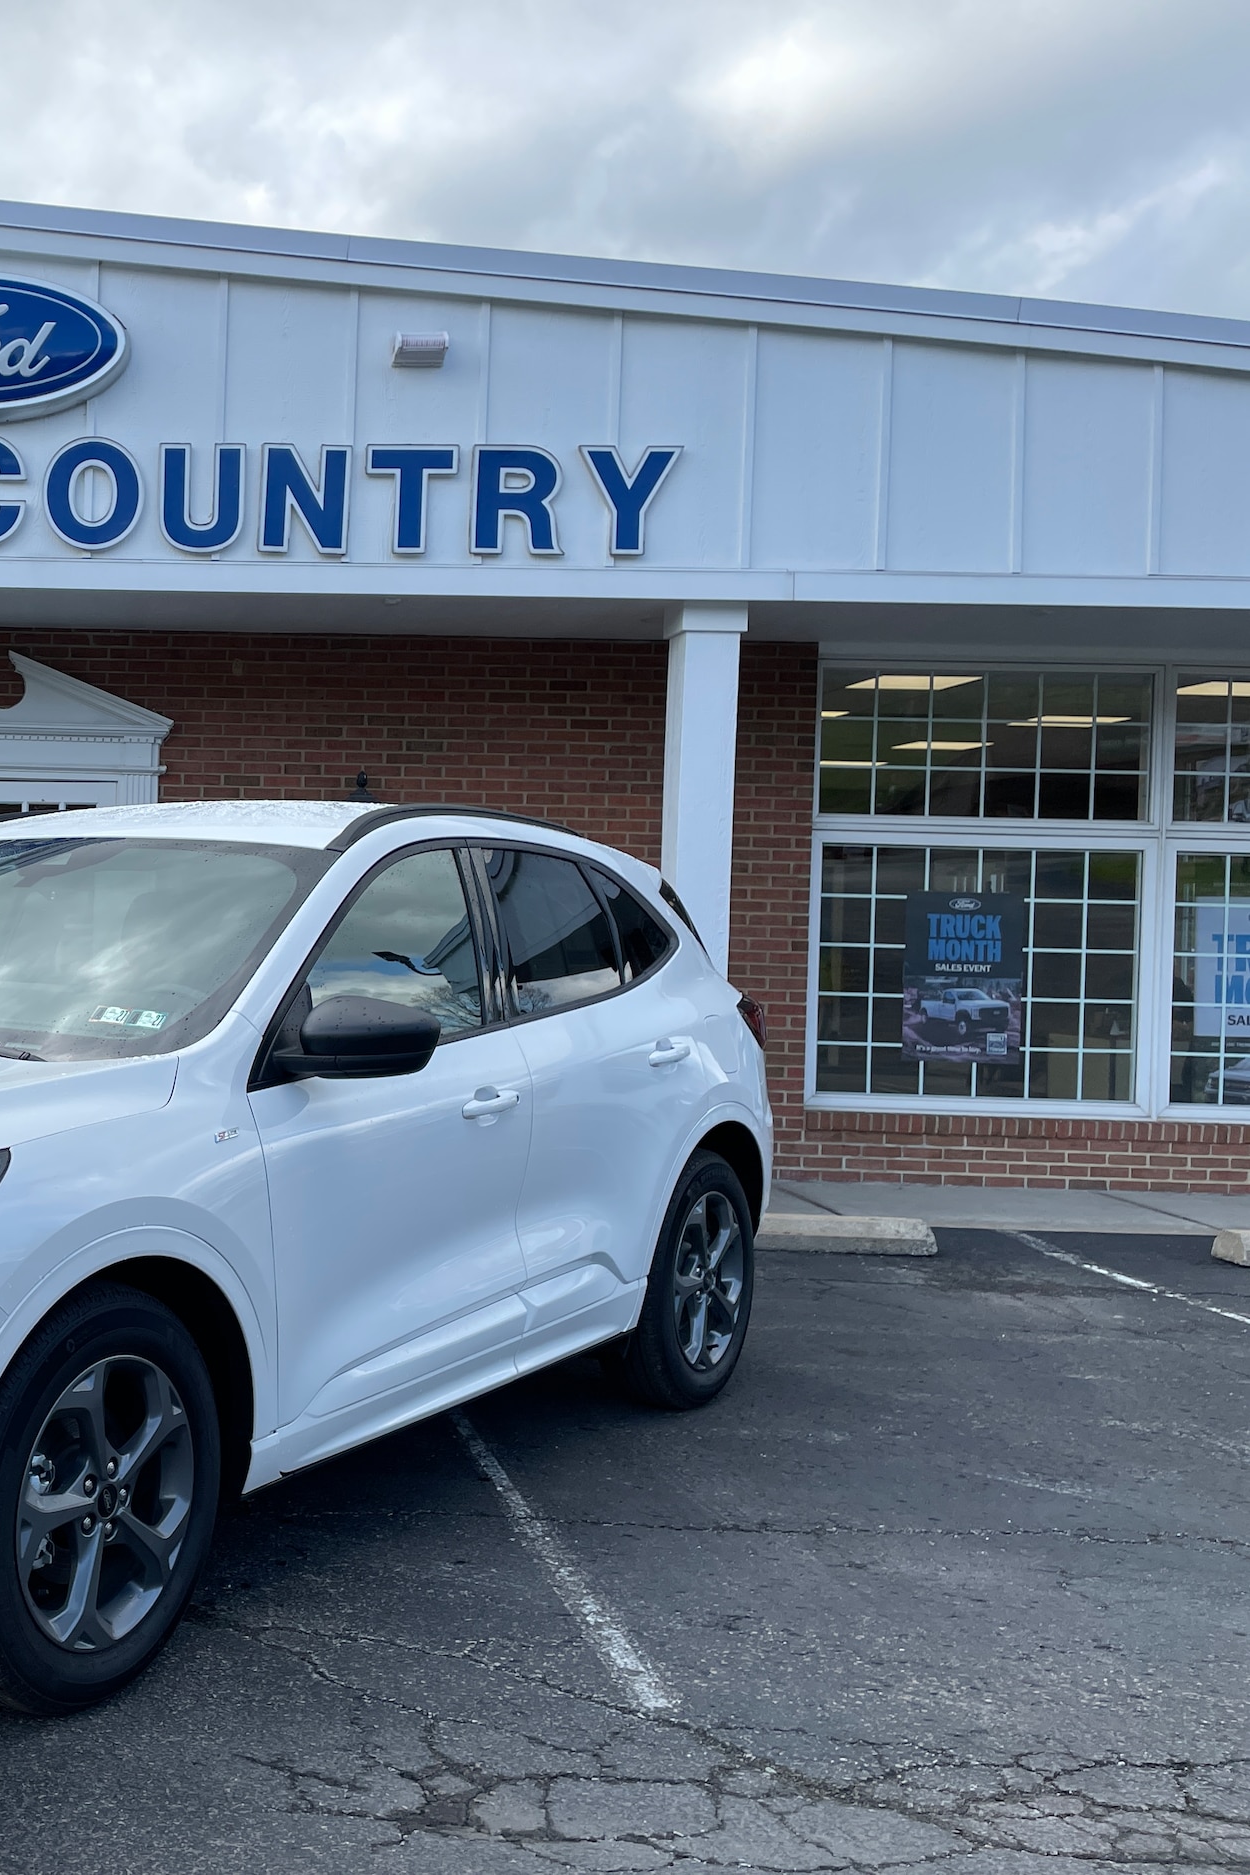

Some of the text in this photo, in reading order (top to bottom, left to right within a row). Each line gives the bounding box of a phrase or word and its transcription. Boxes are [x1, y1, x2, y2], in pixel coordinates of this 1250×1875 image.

[927, 913, 1002, 939] TRUCK
[927, 938, 1002, 962] MONTH
[935, 963, 991, 973] SALES EVENT
